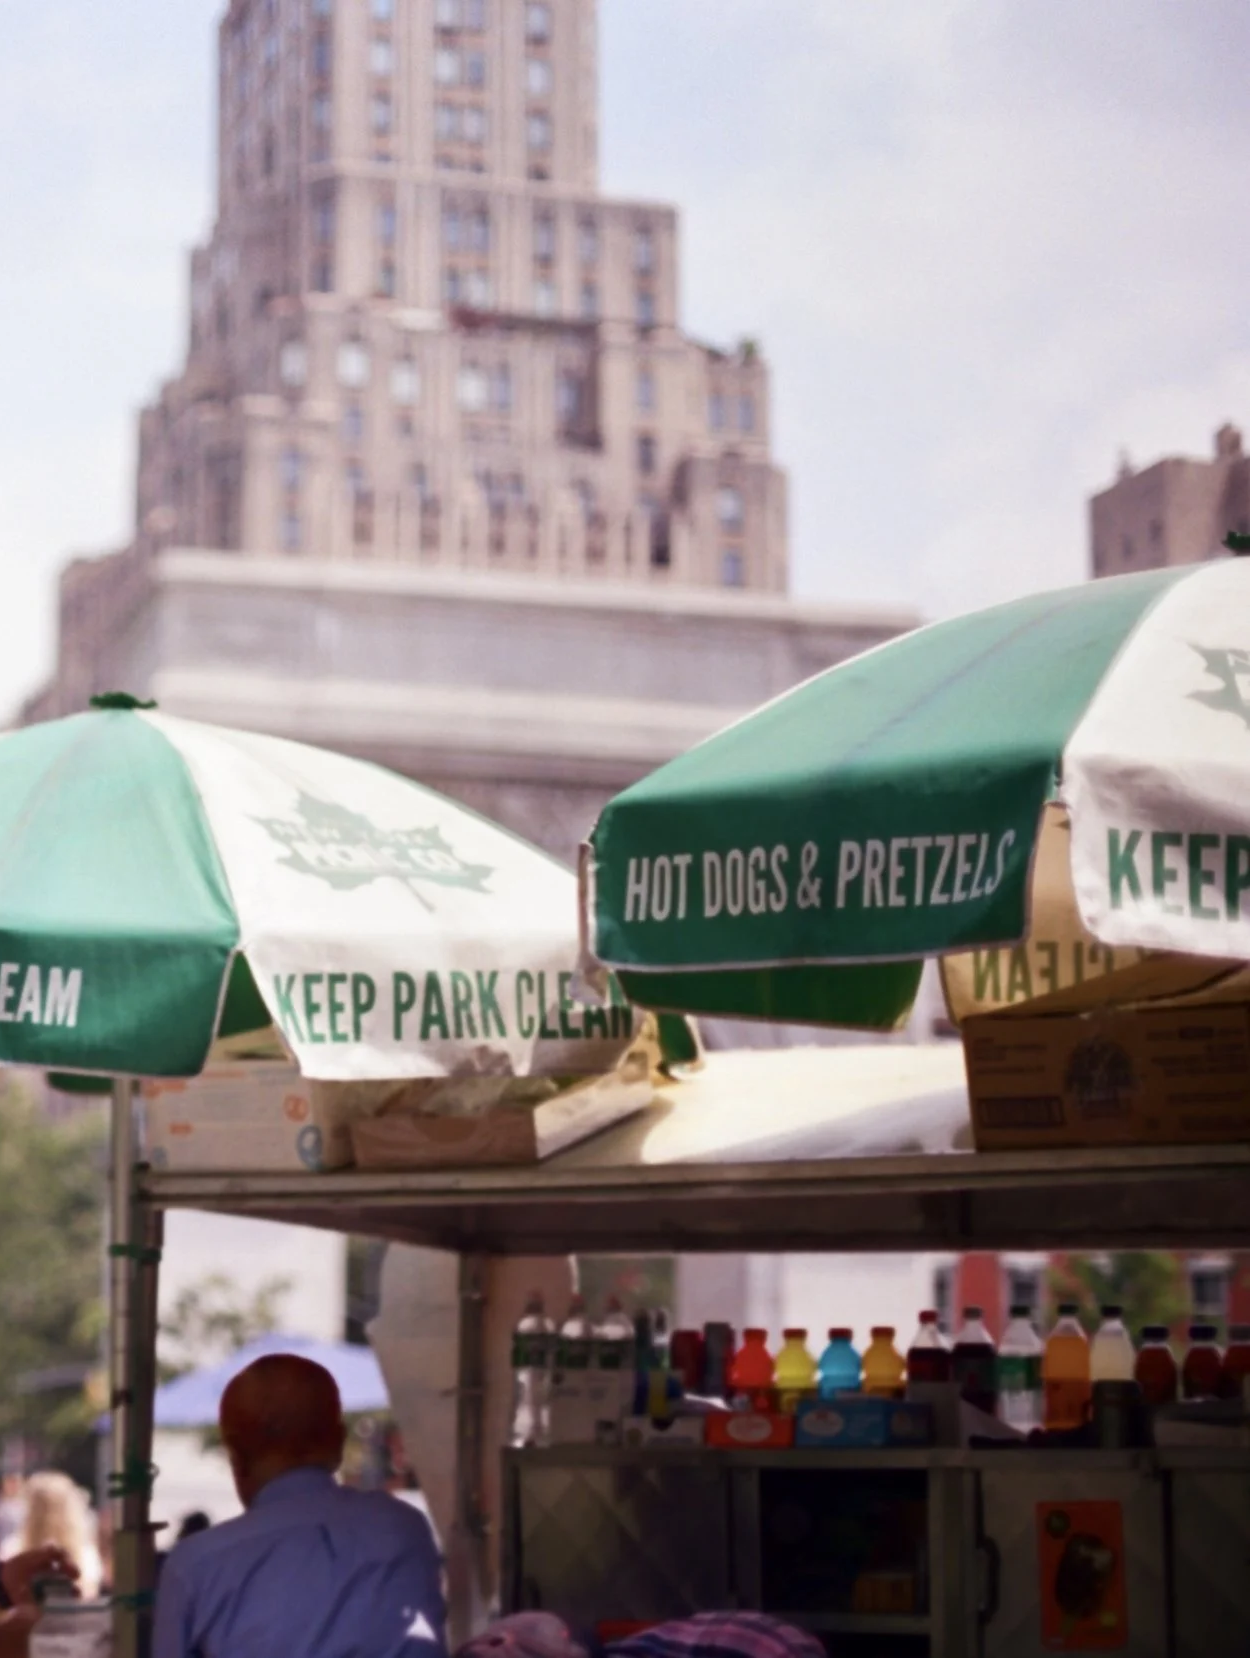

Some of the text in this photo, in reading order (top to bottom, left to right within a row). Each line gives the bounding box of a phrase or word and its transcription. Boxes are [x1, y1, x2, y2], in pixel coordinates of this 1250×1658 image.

[624, 828, 1017, 922] HOT DOGS & PRETZELS
[273, 972, 377, 1043] KEEP
[393, 970, 507, 1041] PARK
